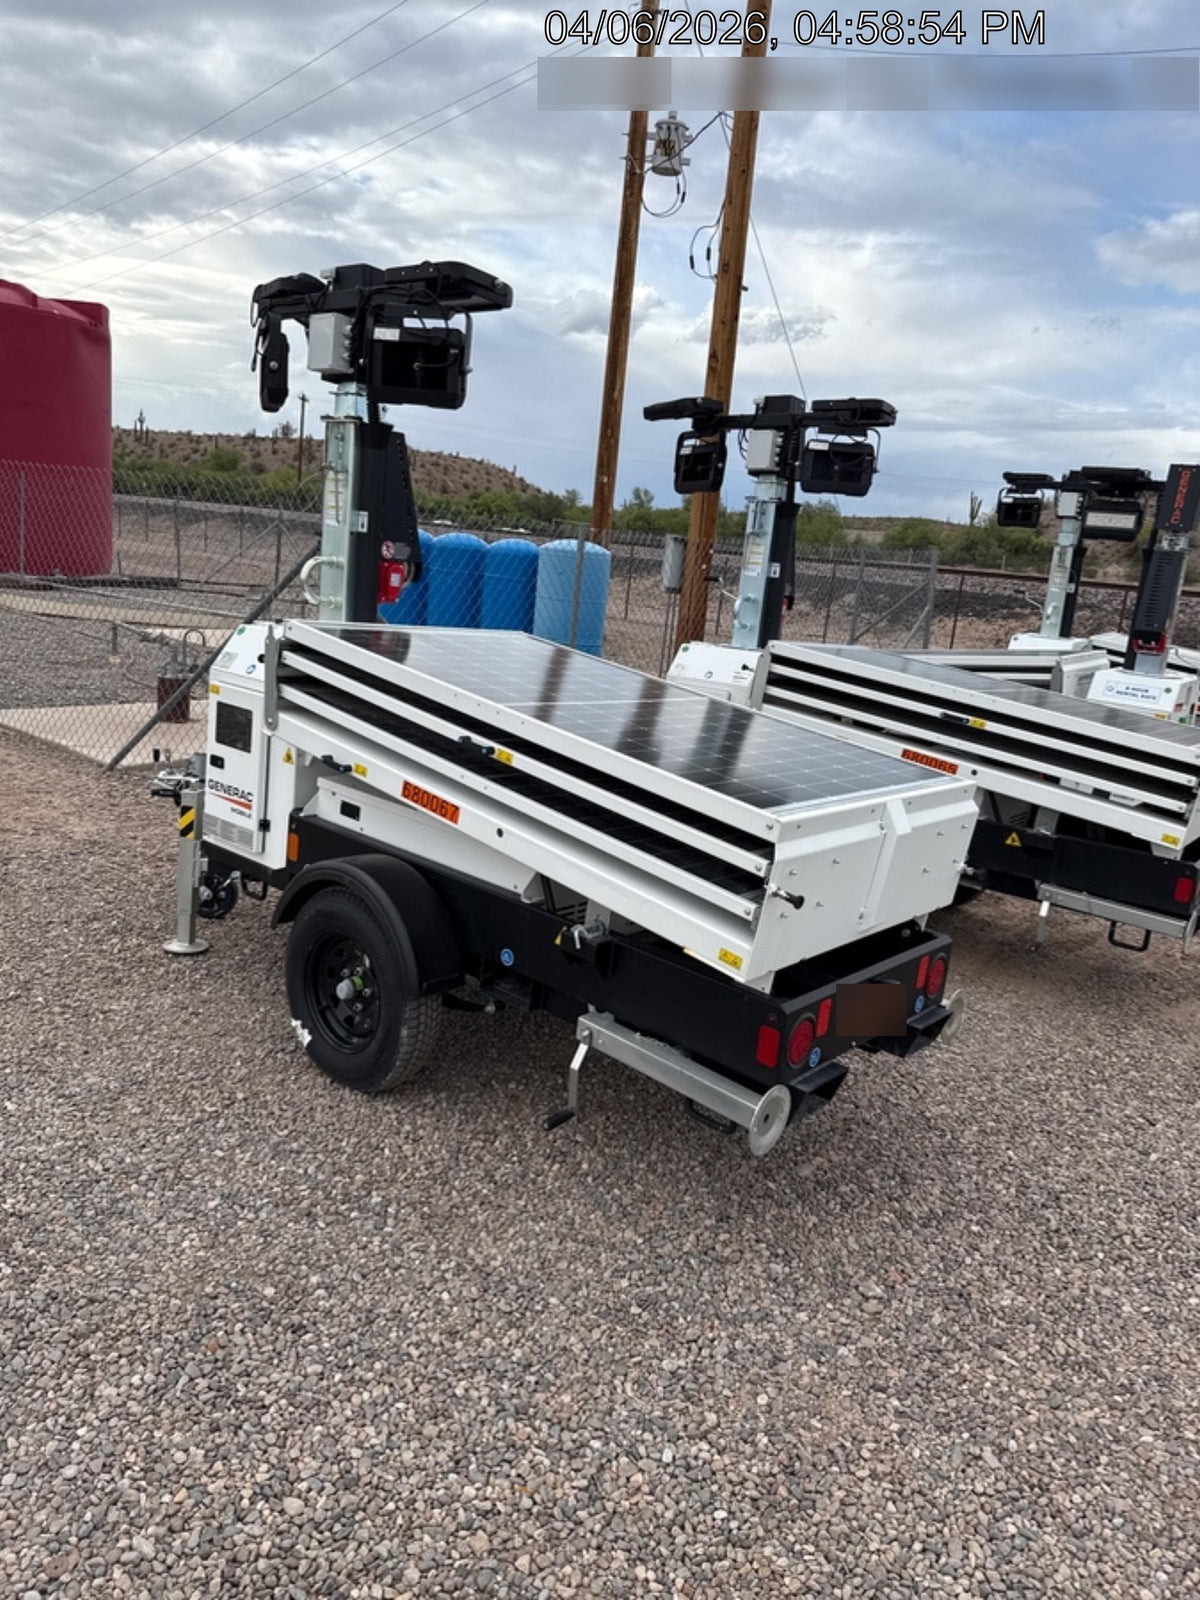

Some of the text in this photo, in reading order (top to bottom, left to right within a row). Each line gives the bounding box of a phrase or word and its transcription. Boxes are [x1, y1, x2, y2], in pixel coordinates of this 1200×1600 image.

[1170, 469, 1192, 524] GENERAC
[207, 778, 254, 802] GENERAC
[402, 780, 460, 825] 680067
